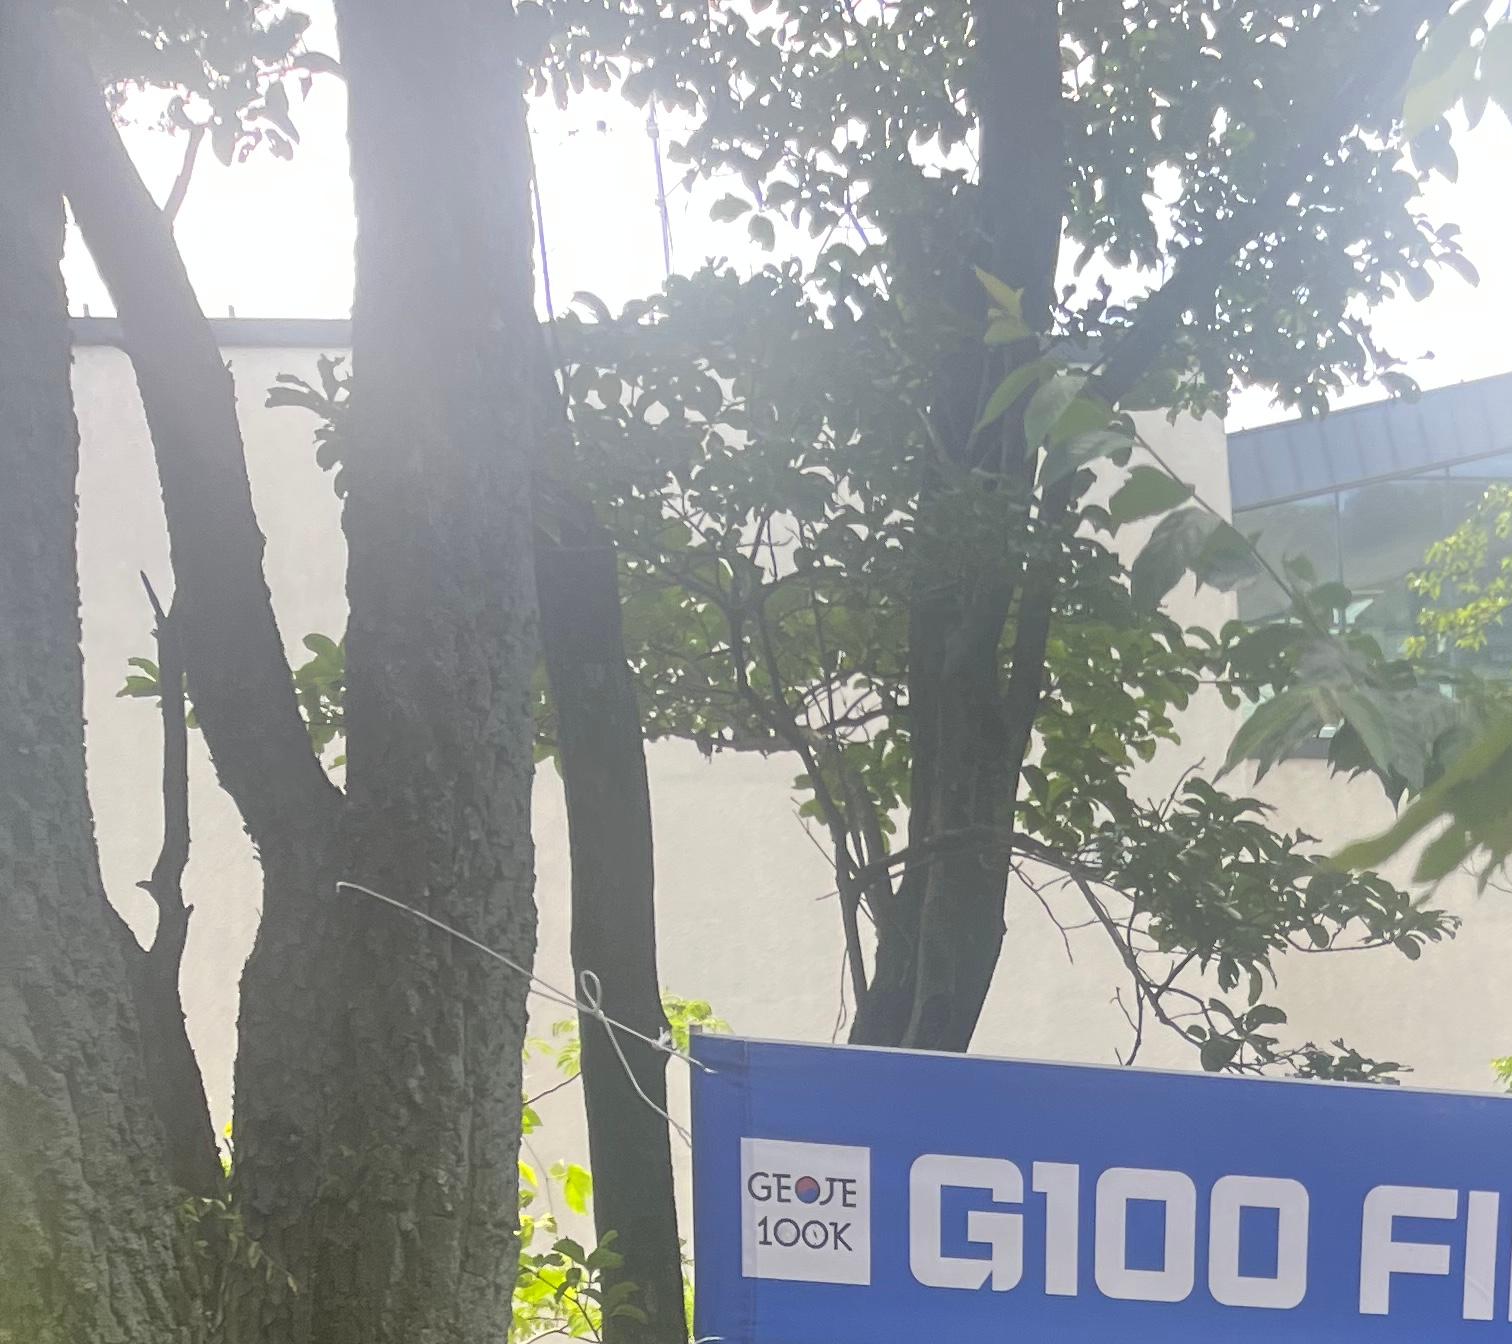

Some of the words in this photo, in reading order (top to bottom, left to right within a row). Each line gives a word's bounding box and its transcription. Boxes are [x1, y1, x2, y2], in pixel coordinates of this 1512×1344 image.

[747, 1171, 857, 1208] GEOJE
[757, 1215, 853, 1252] 100K
[909, 1153, 1310, 1310] G100
